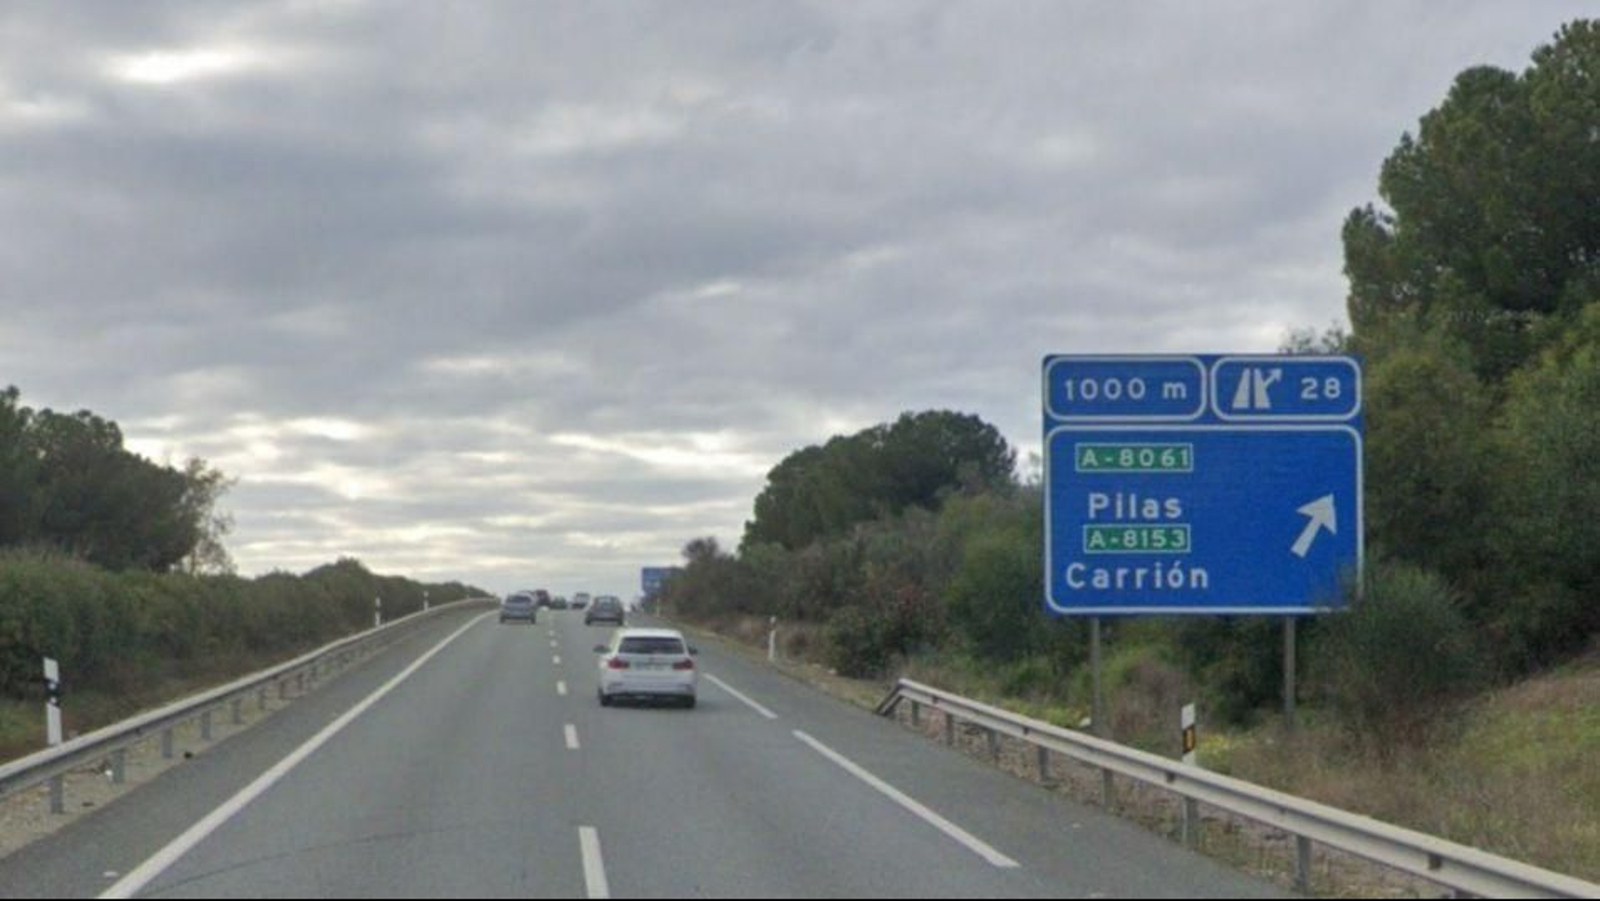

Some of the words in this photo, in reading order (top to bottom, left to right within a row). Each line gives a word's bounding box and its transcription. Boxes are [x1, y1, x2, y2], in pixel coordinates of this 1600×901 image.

[1065, 378, 1146, 400] 1000
[1162, 380, 1187, 399] m
[1300, 377, 1341, 399] 28
[1081, 448, 1189, 467] A-8061
[1088, 492, 1182, 519] Pilas
[1089, 530, 1186, 548] A-8153
[1066, 561, 1208, 589] Carrión
